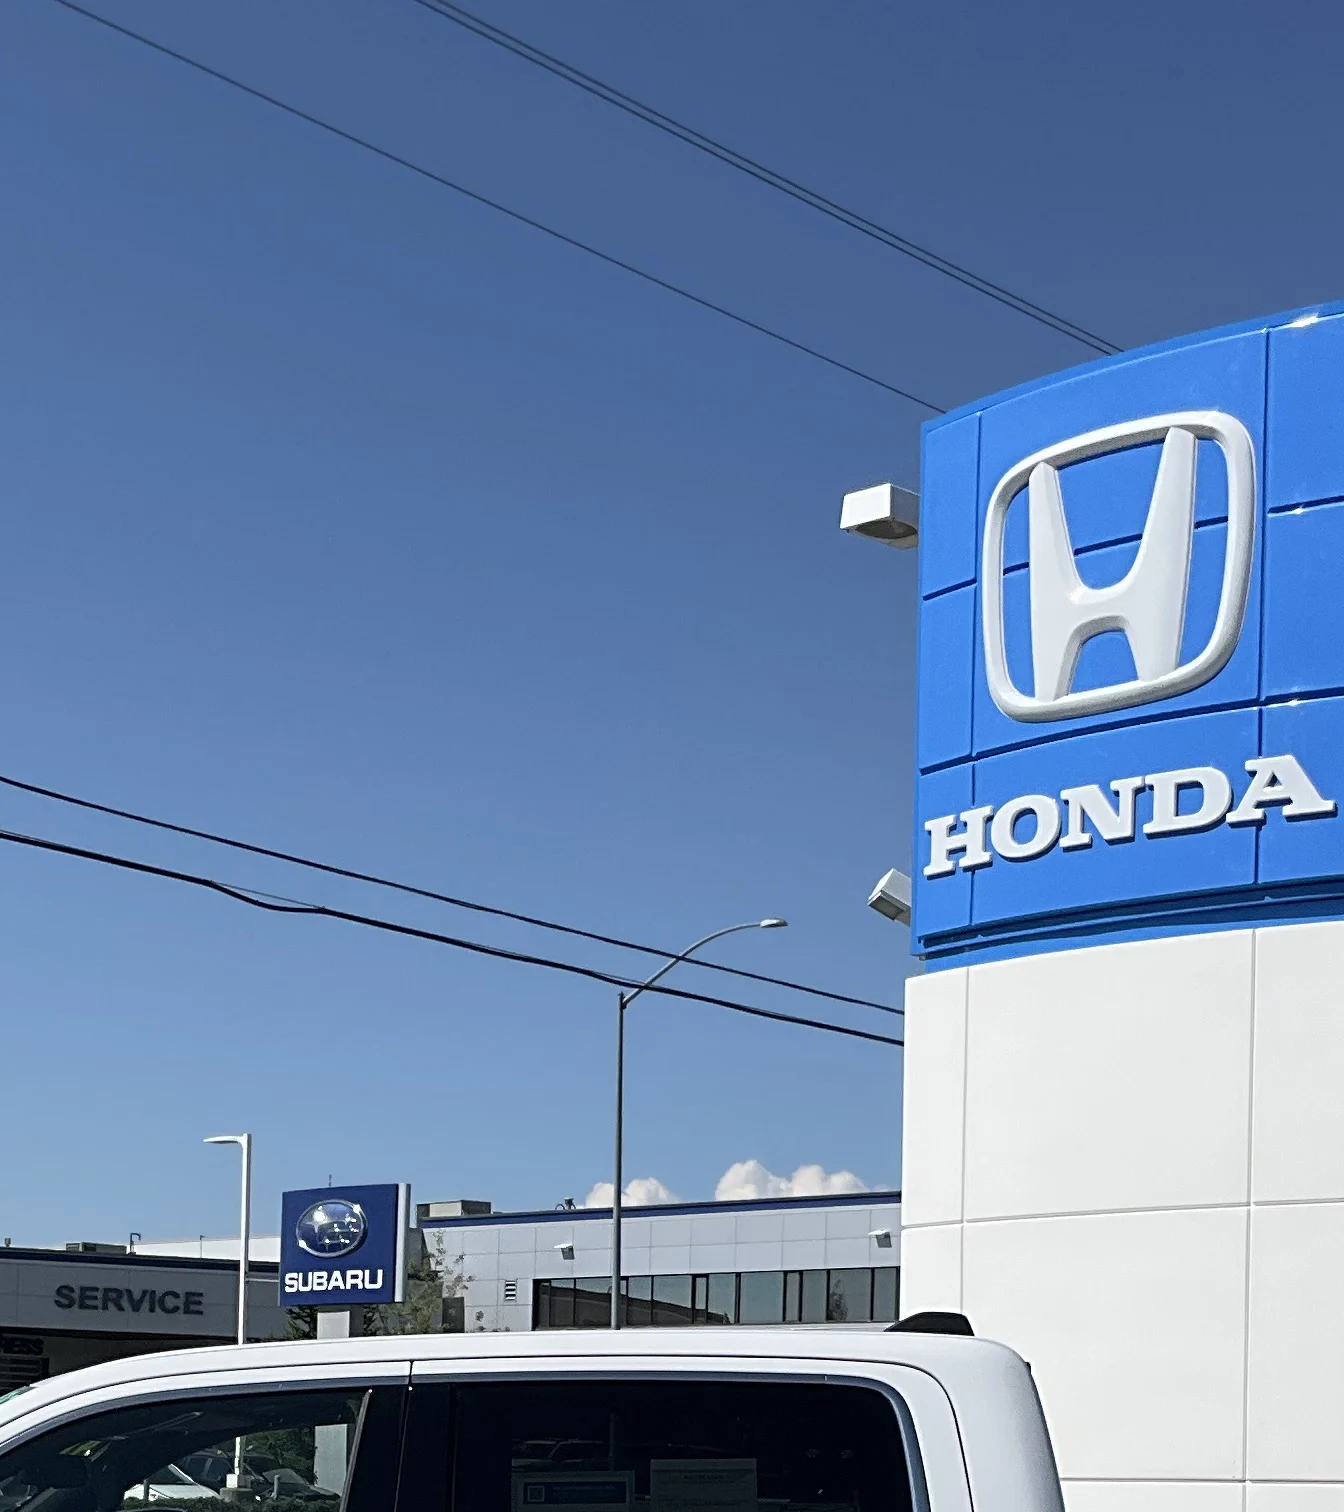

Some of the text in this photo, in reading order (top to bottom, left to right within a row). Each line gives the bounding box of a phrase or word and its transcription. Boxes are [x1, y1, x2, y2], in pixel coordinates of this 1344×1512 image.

[923, 754, 1336, 878] HONDA
[284, 1269, 383, 1293] SUBARU
[54, 1285, 205, 1315] SERVICE
